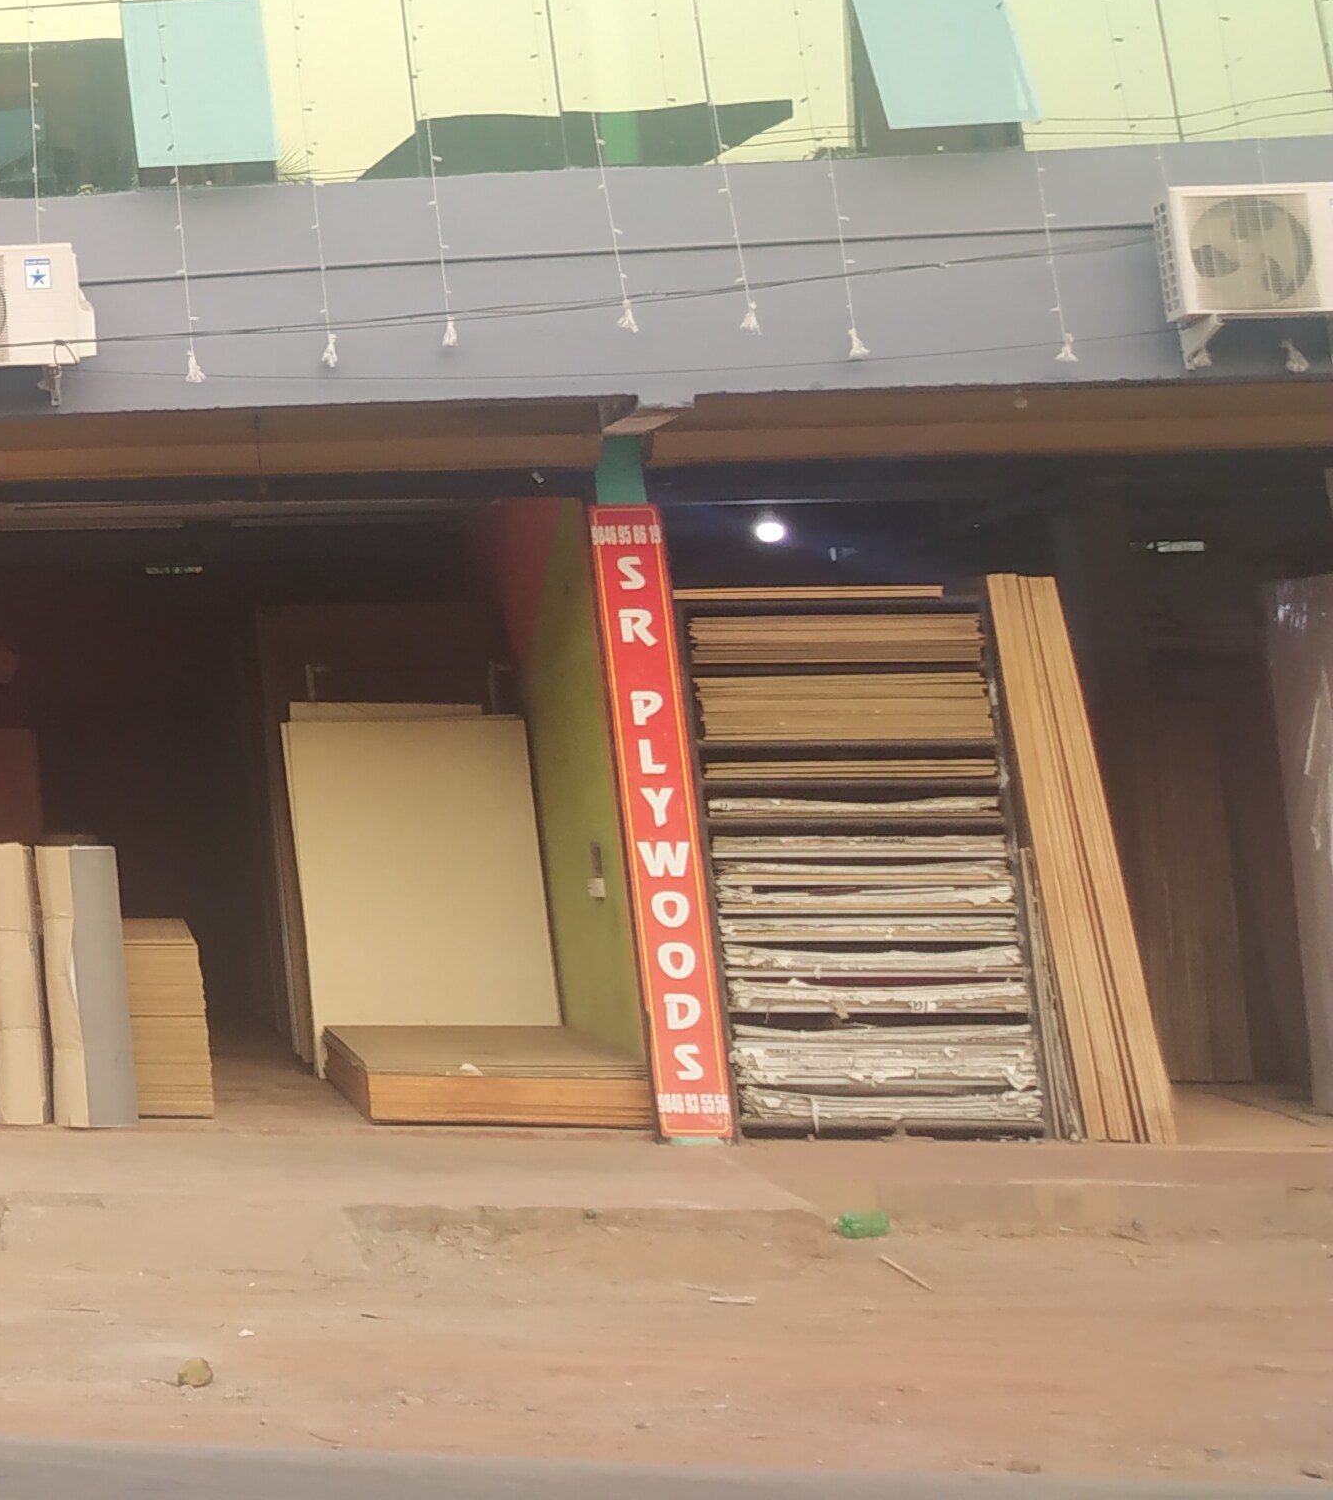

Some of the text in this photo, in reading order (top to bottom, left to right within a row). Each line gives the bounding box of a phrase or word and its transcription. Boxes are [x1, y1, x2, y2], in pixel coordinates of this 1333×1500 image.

[618, 525, 632, 545] 95
[648, 524, 662, 544] 19
[617, 556, 704, 1082] SR PLYWOODS
[685, 1093, 699, 1114] 93
[700, 1093, 715, 1114] 55
